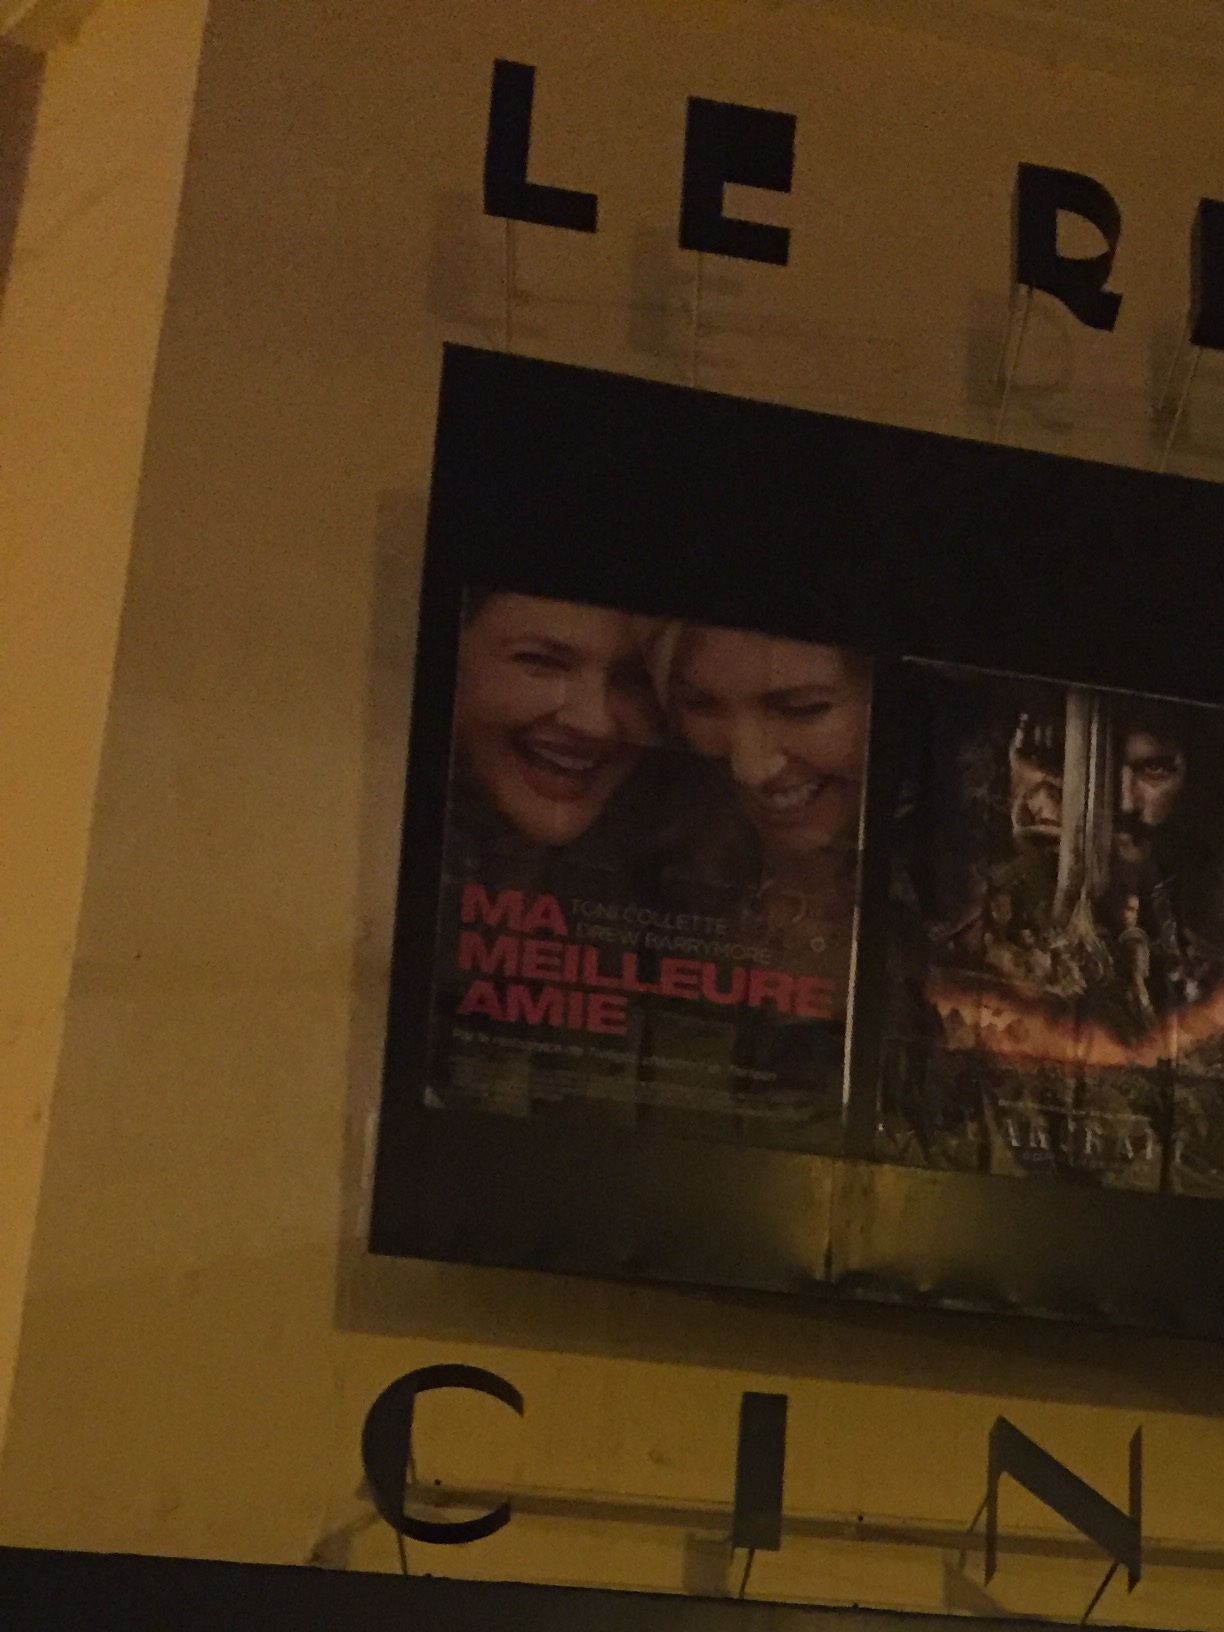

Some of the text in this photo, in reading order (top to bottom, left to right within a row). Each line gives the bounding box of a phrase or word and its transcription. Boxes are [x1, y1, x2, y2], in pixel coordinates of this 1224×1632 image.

[483, 57, 797, 266] LE
[460, 883, 568, 937] MA
[572, 898, 728, 937] TONI COLLETTE
[575, 921, 773, 966] DREW BARRYMORE
[457, 931, 837, 1019] MEILLEURE
[456, 979, 628, 1036] AMIE
